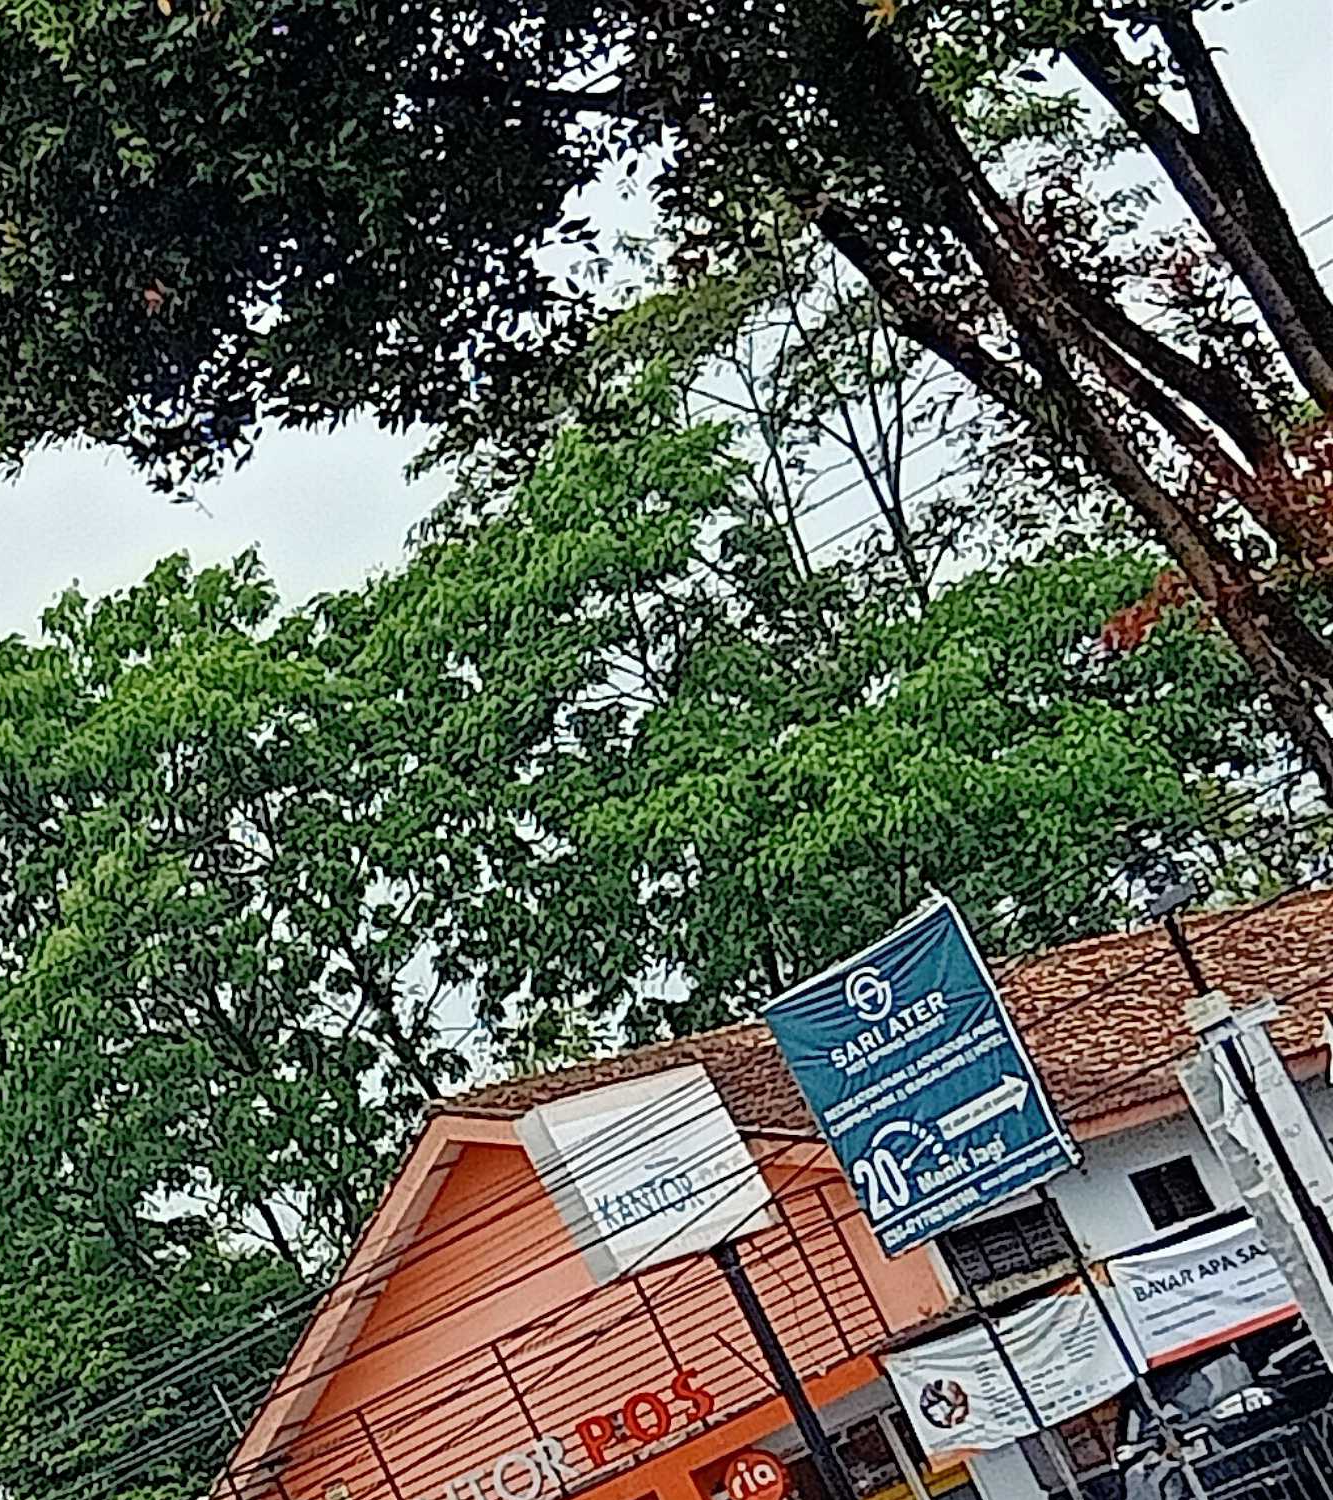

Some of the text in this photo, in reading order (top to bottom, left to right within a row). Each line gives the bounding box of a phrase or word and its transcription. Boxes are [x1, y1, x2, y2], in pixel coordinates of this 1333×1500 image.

[830, 991, 950, 1069] SARI ATER
[593, 1172, 706, 1230] KANTOR
[852, 1148, 910, 1221] 20
[1131, 1266, 1194, 1302] BAYAR
[1196, 1252, 1238, 1281] APA
[574, 1366, 715, 1468] POS
